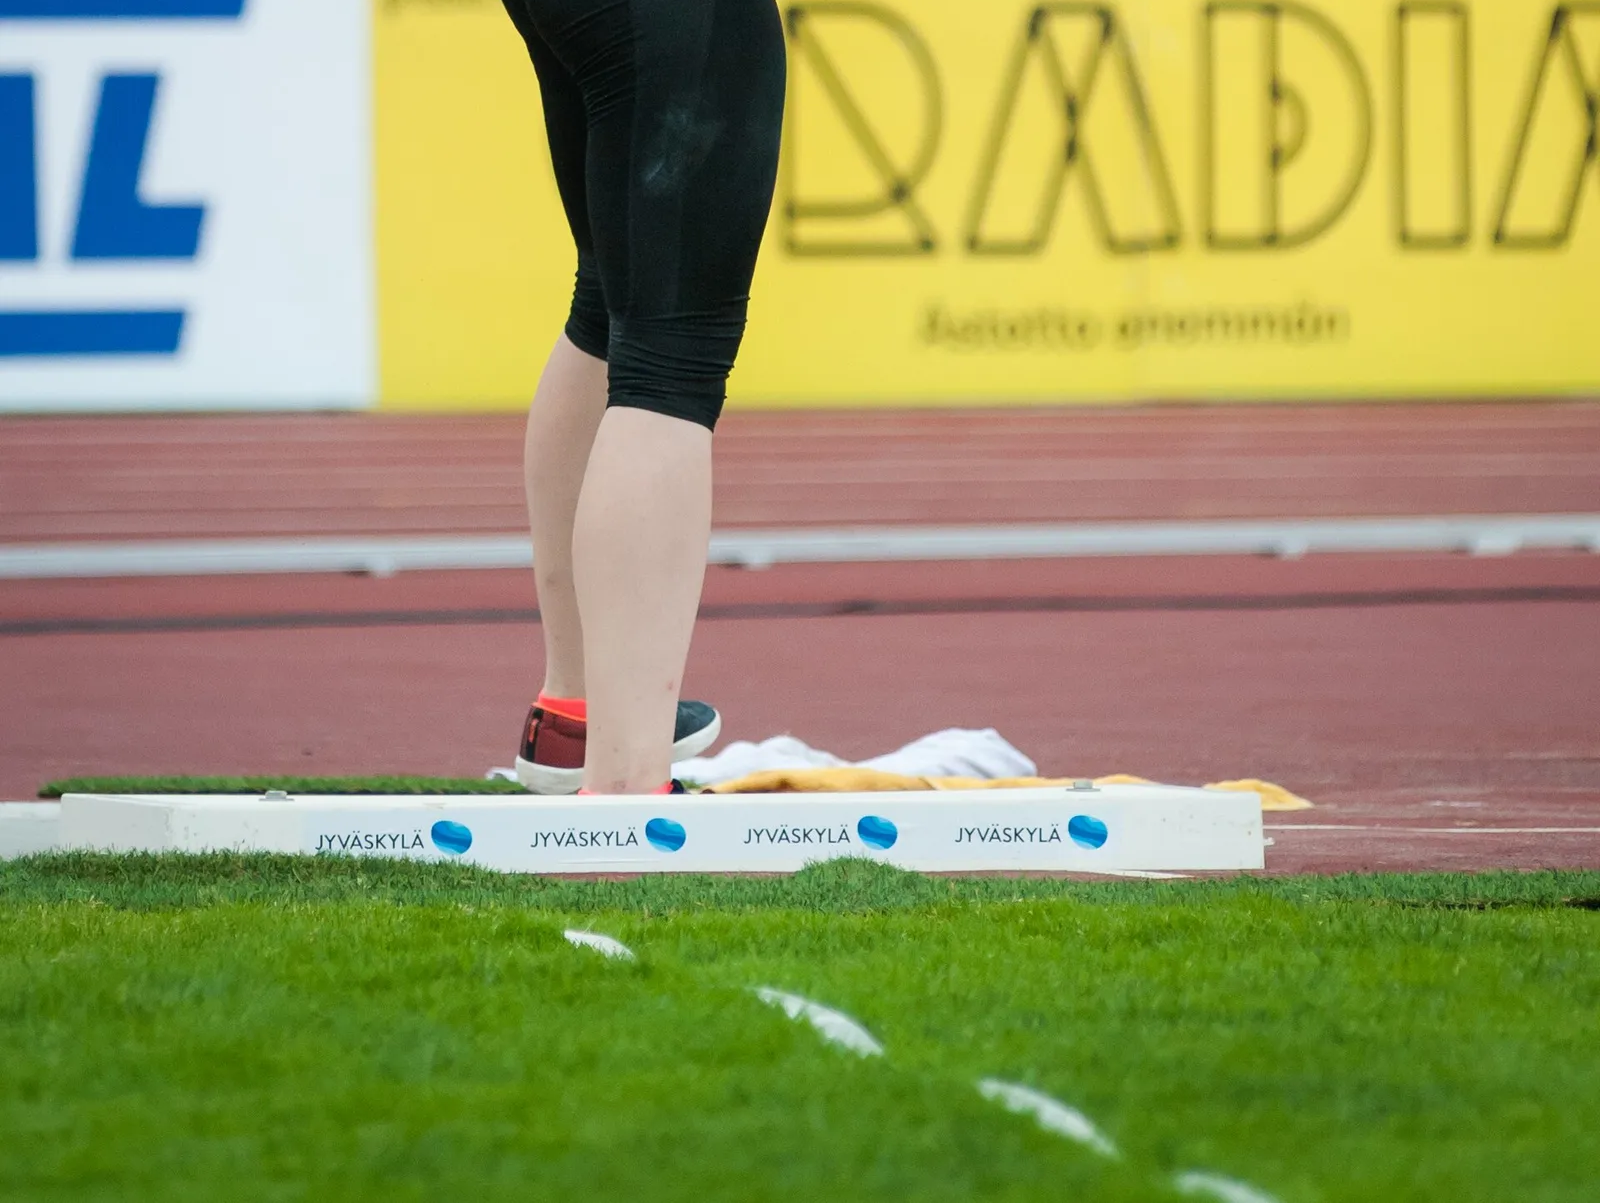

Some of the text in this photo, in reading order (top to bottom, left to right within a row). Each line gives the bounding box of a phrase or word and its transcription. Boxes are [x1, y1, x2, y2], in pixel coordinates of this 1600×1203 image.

[314, 829, 425, 852] JYVÄSKYLÄ
[530, 826, 639, 849] JYVÄSKYLÄ
[743, 824, 851, 845] JYVÄSKYLÄ
[954, 823, 1062, 844] JYVÄSKYLÄ
